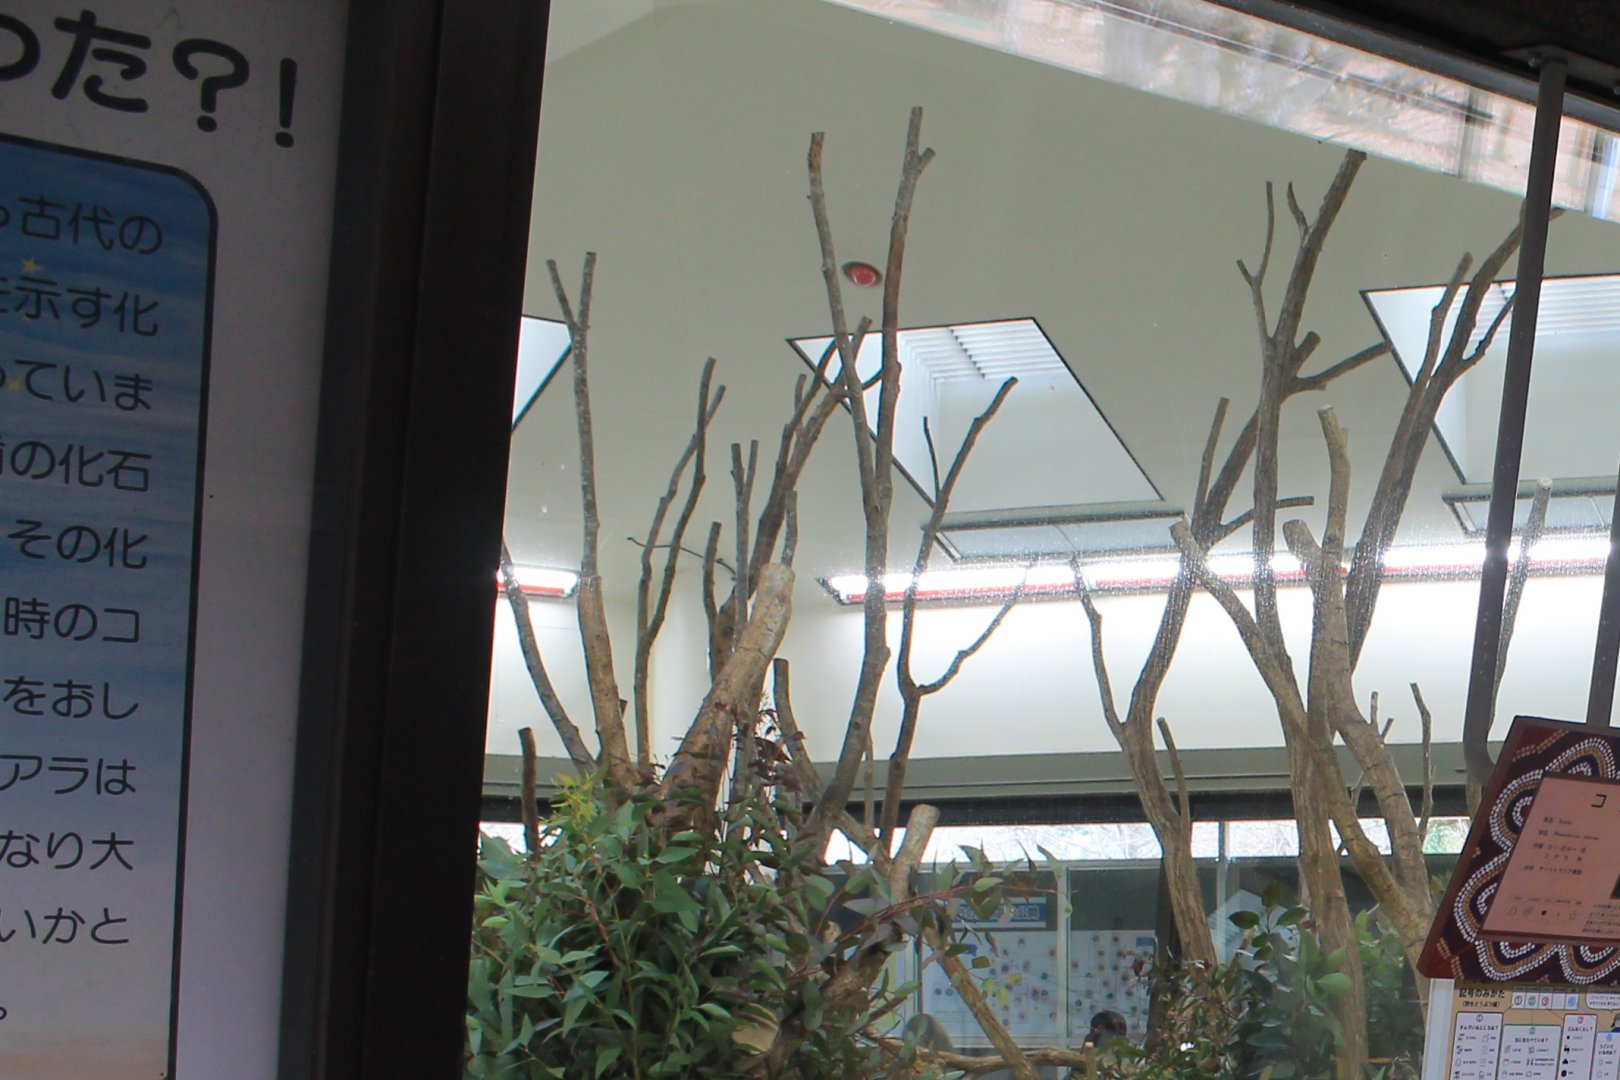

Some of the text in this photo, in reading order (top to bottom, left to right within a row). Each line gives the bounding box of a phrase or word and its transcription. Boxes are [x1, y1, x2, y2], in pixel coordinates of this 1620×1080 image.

[0, 195, 163, 254] 古代の
[0, 275, 159, 336] 示す化
[0, 359, 153, 410] ていま
[0, 436, 152, 492] の化石
[8, 519, 148, 569] その化
[4, 597, 140, 643] 時のコ
[4, 676, 139, 720] をおし
[0, 753, 136, 796] アラは
[0, 830, 133, 871] なり大
[0, 907, 129, 945] いかと
